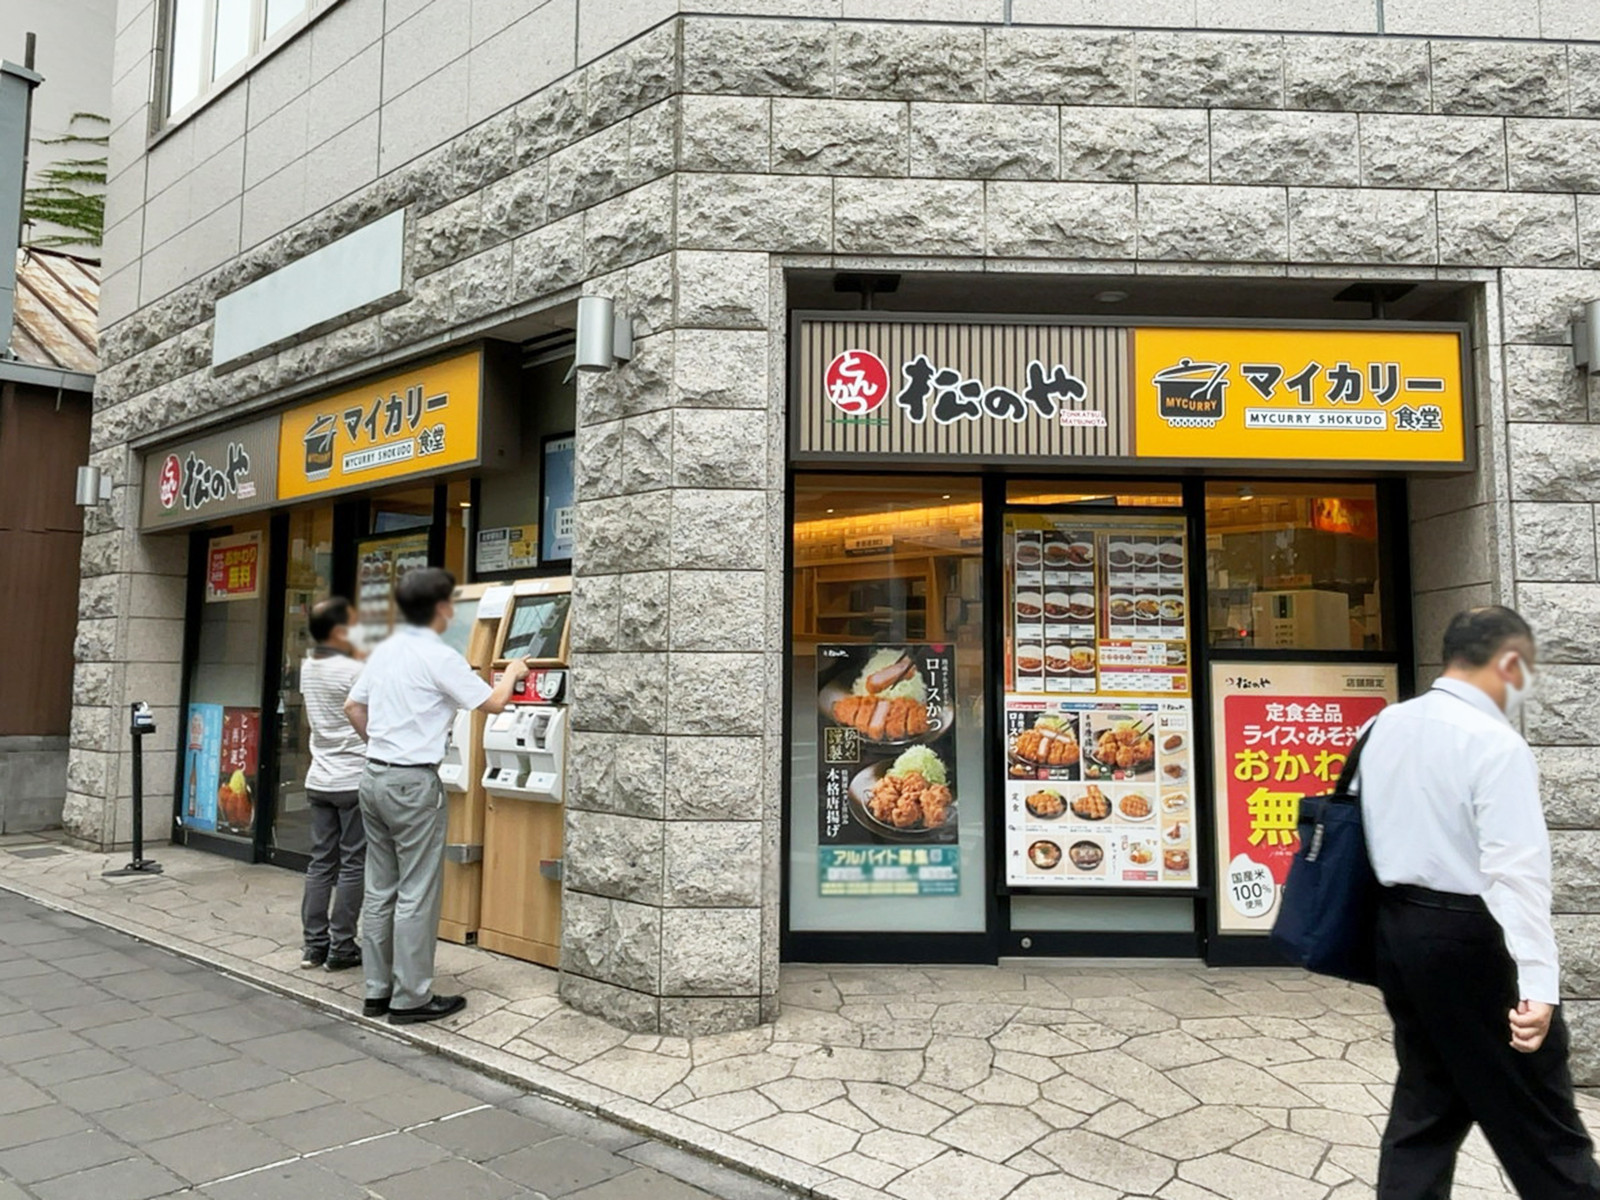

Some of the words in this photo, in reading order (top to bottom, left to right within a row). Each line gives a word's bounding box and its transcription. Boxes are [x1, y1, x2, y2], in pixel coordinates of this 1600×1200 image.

[829, 351, 877, 413] とんかつ
[898, 356, 1086, 423] 松のや
[1242, 362, 1443, 404] マイカリー
[343, 385, 449, 441] マイカリー
[1165, 396, 1217, 412] MYCURRY
[1395, 405, 1442, 430] 食堂
[1250, 413, 1311, 424] MYCURRY
[1318, 414, 1383, 425] SHOKUDO
[418, 425, 445, 455] 食堂
[345, 451, 375, 470] MYCURRY
[378, 442, 412, 462] SHOKUDO
[183, 444, 249, 509] 松のや
[925, 658, 942, 731] ロースかつ
[1346, 678, 1384, 688] 店舗限定
[1266, 703, 1343, 722] 定食全品
[825, 767, 841, 838] 本格唐揚げ
[1231, 868, 1266, 884] 国産米
[1232, 882, 1272, 901] 100%
[1244, 898, 1263, 910] 使用
